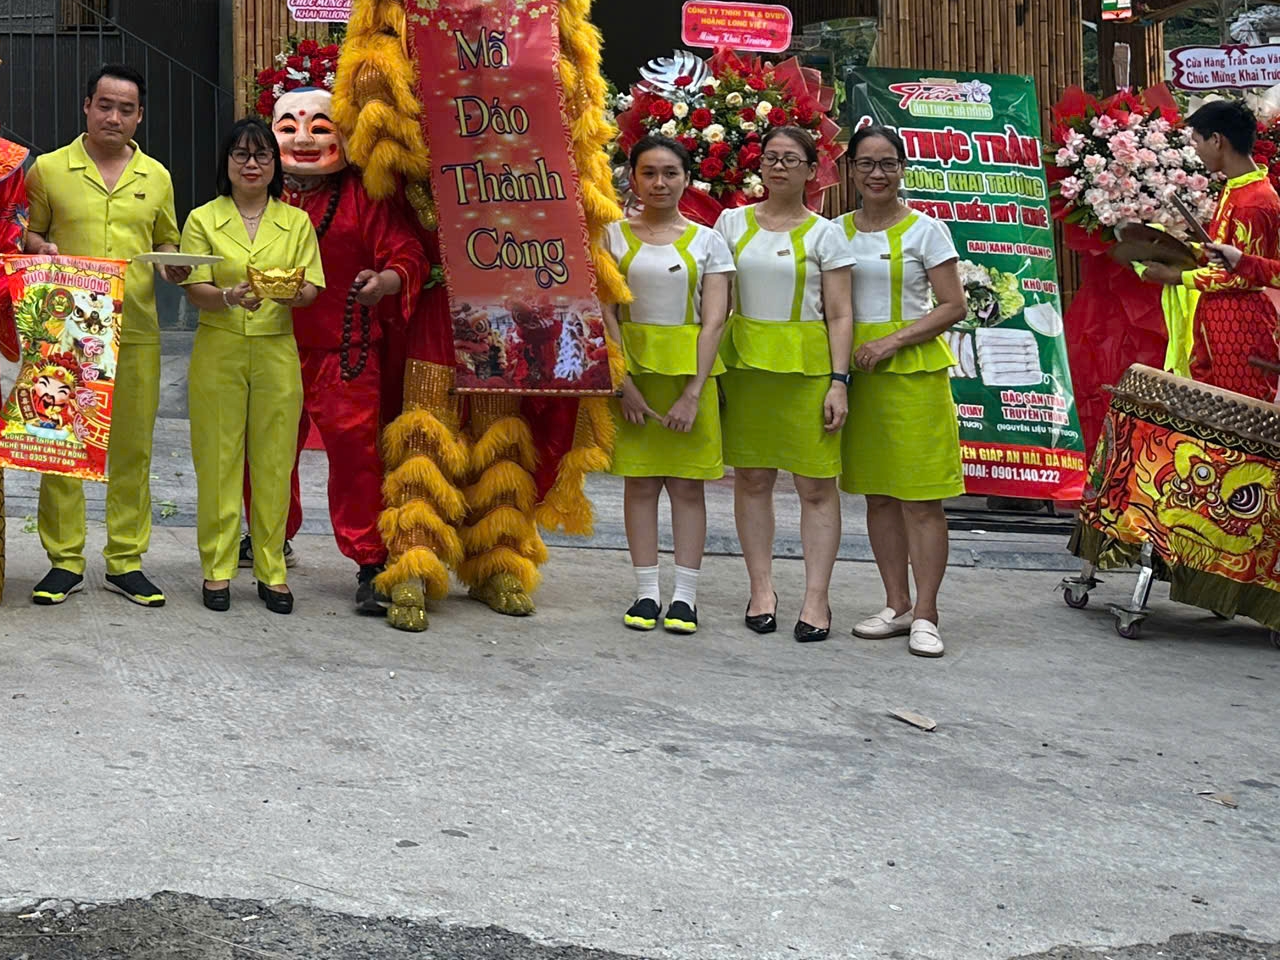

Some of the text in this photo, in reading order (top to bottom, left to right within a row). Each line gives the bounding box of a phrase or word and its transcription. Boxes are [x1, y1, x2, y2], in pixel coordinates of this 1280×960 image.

[296, 9, 317, 18] KHAI
[687, 6, 707, 14] CÔNG
[709, 7, 719, 15] TY
[720, 8, 741, 17] TNHH
[722, 32, 741, 42] Khai
[454, 26, 509, 70] Mã
[1204, 56, 1226, 68] Hàng
[1250, 54, 1266, 65] Cao
[1186, 71, 1210, 84] Chúc
[1211, 70, 1236, 84] Mừng
[1238, 69, 1259, 82] Khai
[454, 96, 530, 137] Đáo
[900, 125, 1041, 169] THỰC TRẦN
[441, 157, 568, 205] Thành
[946, 170, 986, 194] KHAI
[987, 172, 1045, 200] TRƯƠNG
[955, 197, 992, 223] BIỂN
[993, 201, 1018, 224] MỸ
[1020, 204, 1049, 229] KHÊ
[466, 228, 570, 289] Công
[968, 241, 1052, 259] RAU XANH ORGANIC
[53, 271, 75, 286] ANH
[1022, 278, 1040, 291] KHÔ
[1001, 390, 1022, 406] ĐẶC
[1023, 391, 1043, 407] SẢN
[960, 404, 984, 417] QUAY
[1002, 405, 1040, 420] TRUYỀN
[1031, 425, 1046, 434] LIỆU
[1006, 449, 1020, 462] AN
[1044, 452, 1060, 468] ĐÀ
[1061, 454, 1084, 471] NẴNG
[991, 466, 1060, 483] 0901.140.222
